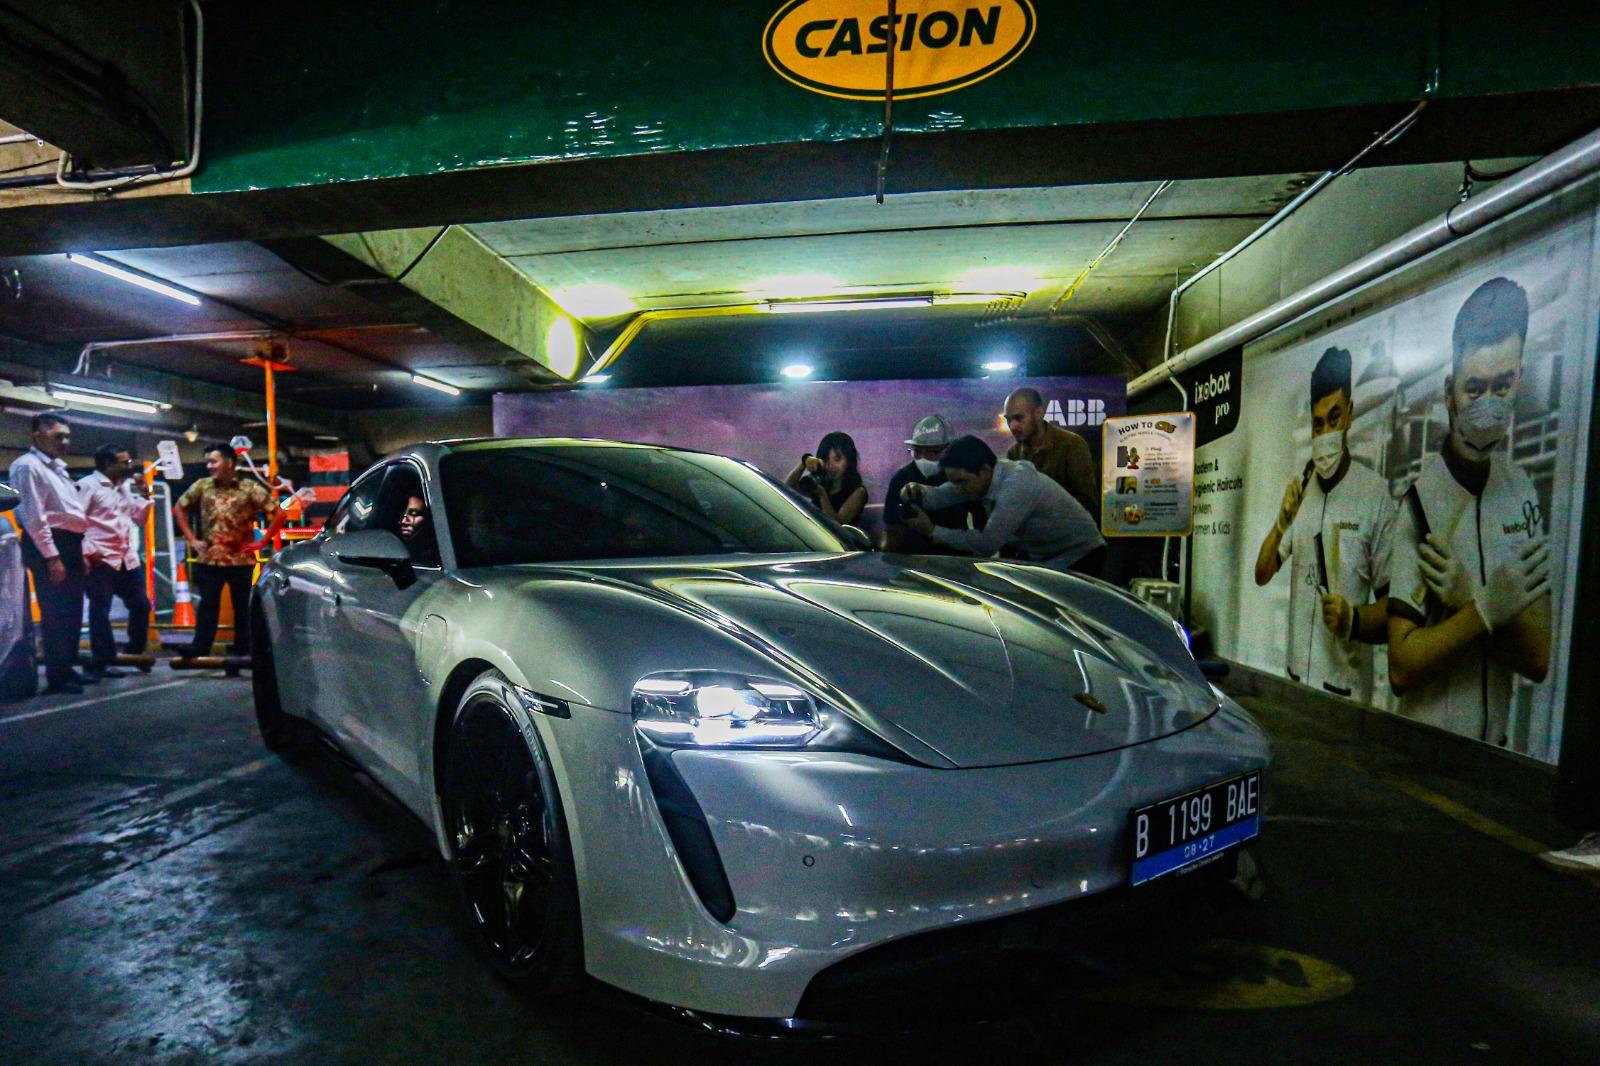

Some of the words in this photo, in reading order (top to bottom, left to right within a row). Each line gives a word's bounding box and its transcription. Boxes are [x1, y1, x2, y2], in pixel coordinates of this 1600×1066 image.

[795, 6, 1001, 58] CASION
[1043, 399, 1106, 426] ABB
[1215, 402, 1229, 425] pro
[1118, 422, 1139, 435] HOW
[1137, 814, 1149, 858] B
[1169, 793, 1212, 845] 1199
[1226, 776, 1257, 822] BAE
